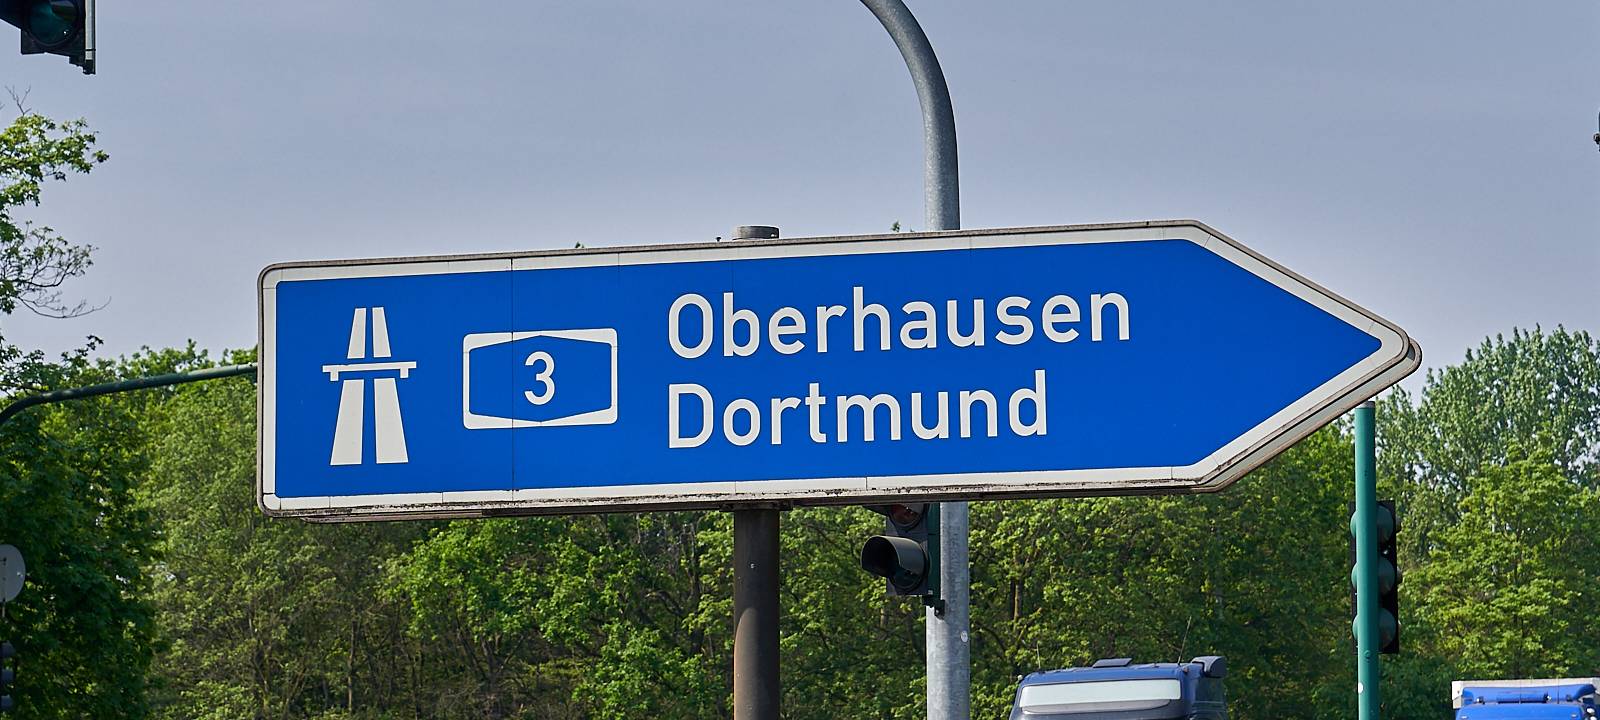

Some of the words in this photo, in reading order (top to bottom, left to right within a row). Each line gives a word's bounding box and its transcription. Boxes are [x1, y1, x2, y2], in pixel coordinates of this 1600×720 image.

[668, 286, 1131, 359] Oberhausen
[524, 351, 555, 406] 3
[668, 369, 1047, 449] Dortmund
